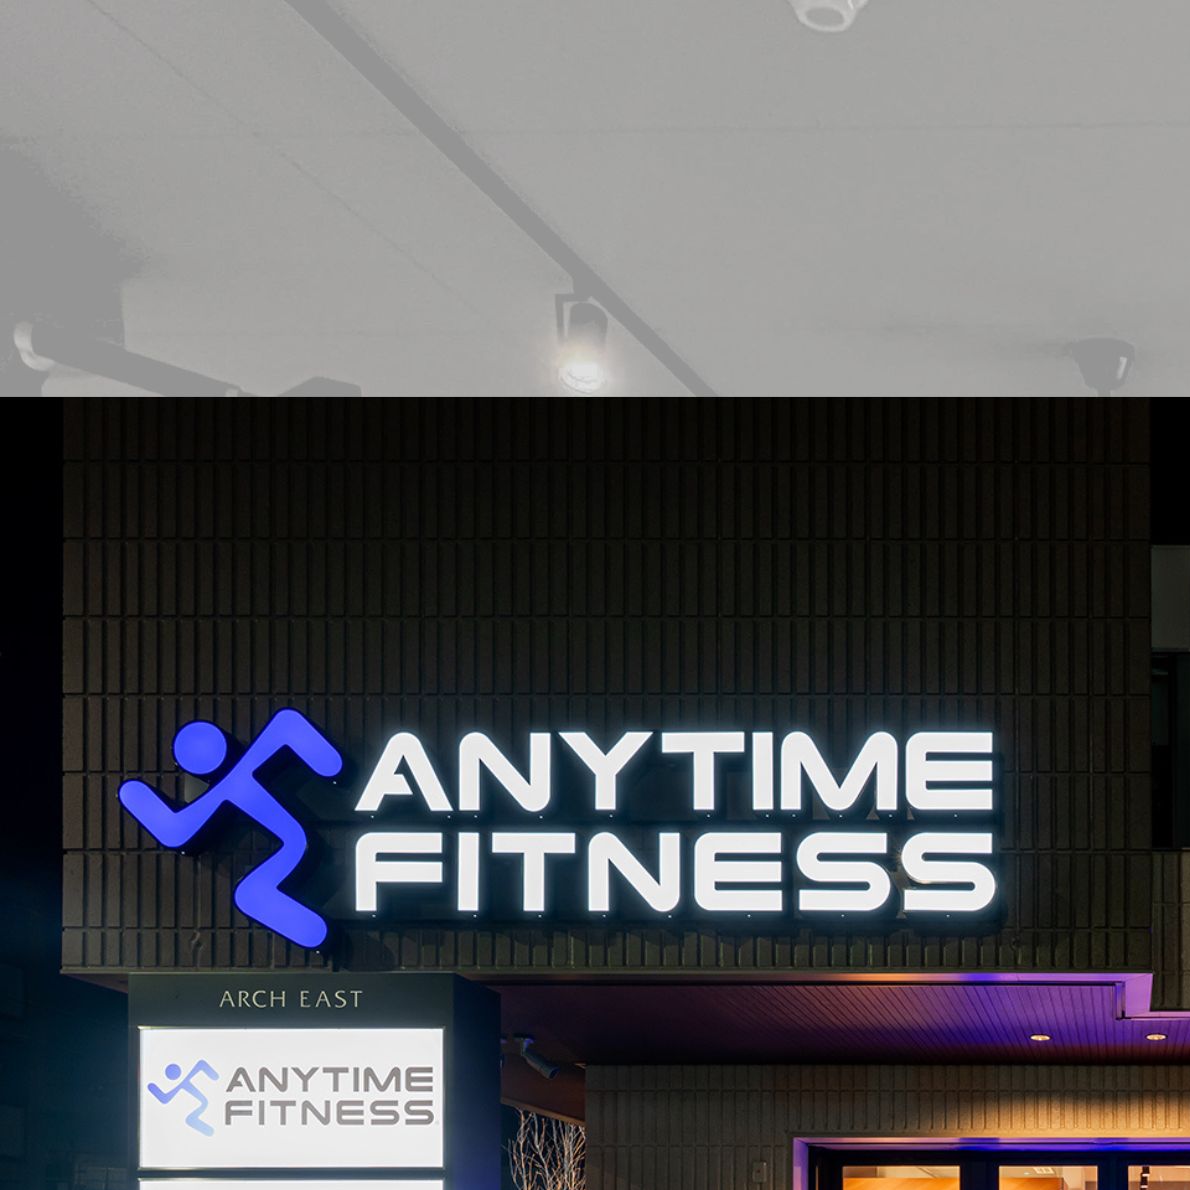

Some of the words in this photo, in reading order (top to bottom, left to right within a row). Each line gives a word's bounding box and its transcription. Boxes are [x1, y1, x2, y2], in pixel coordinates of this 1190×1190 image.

[354, 731, 994, 812] ANYTIME
[355, 832, 996, 913] FITNESS
[219, 990, 286, 1008] ARCH
[300, 990, 363, 1008] EAST
[226, 1066, 434, 1093] ANYTIME
[224, 1099, 435, 1126] FITNESS
